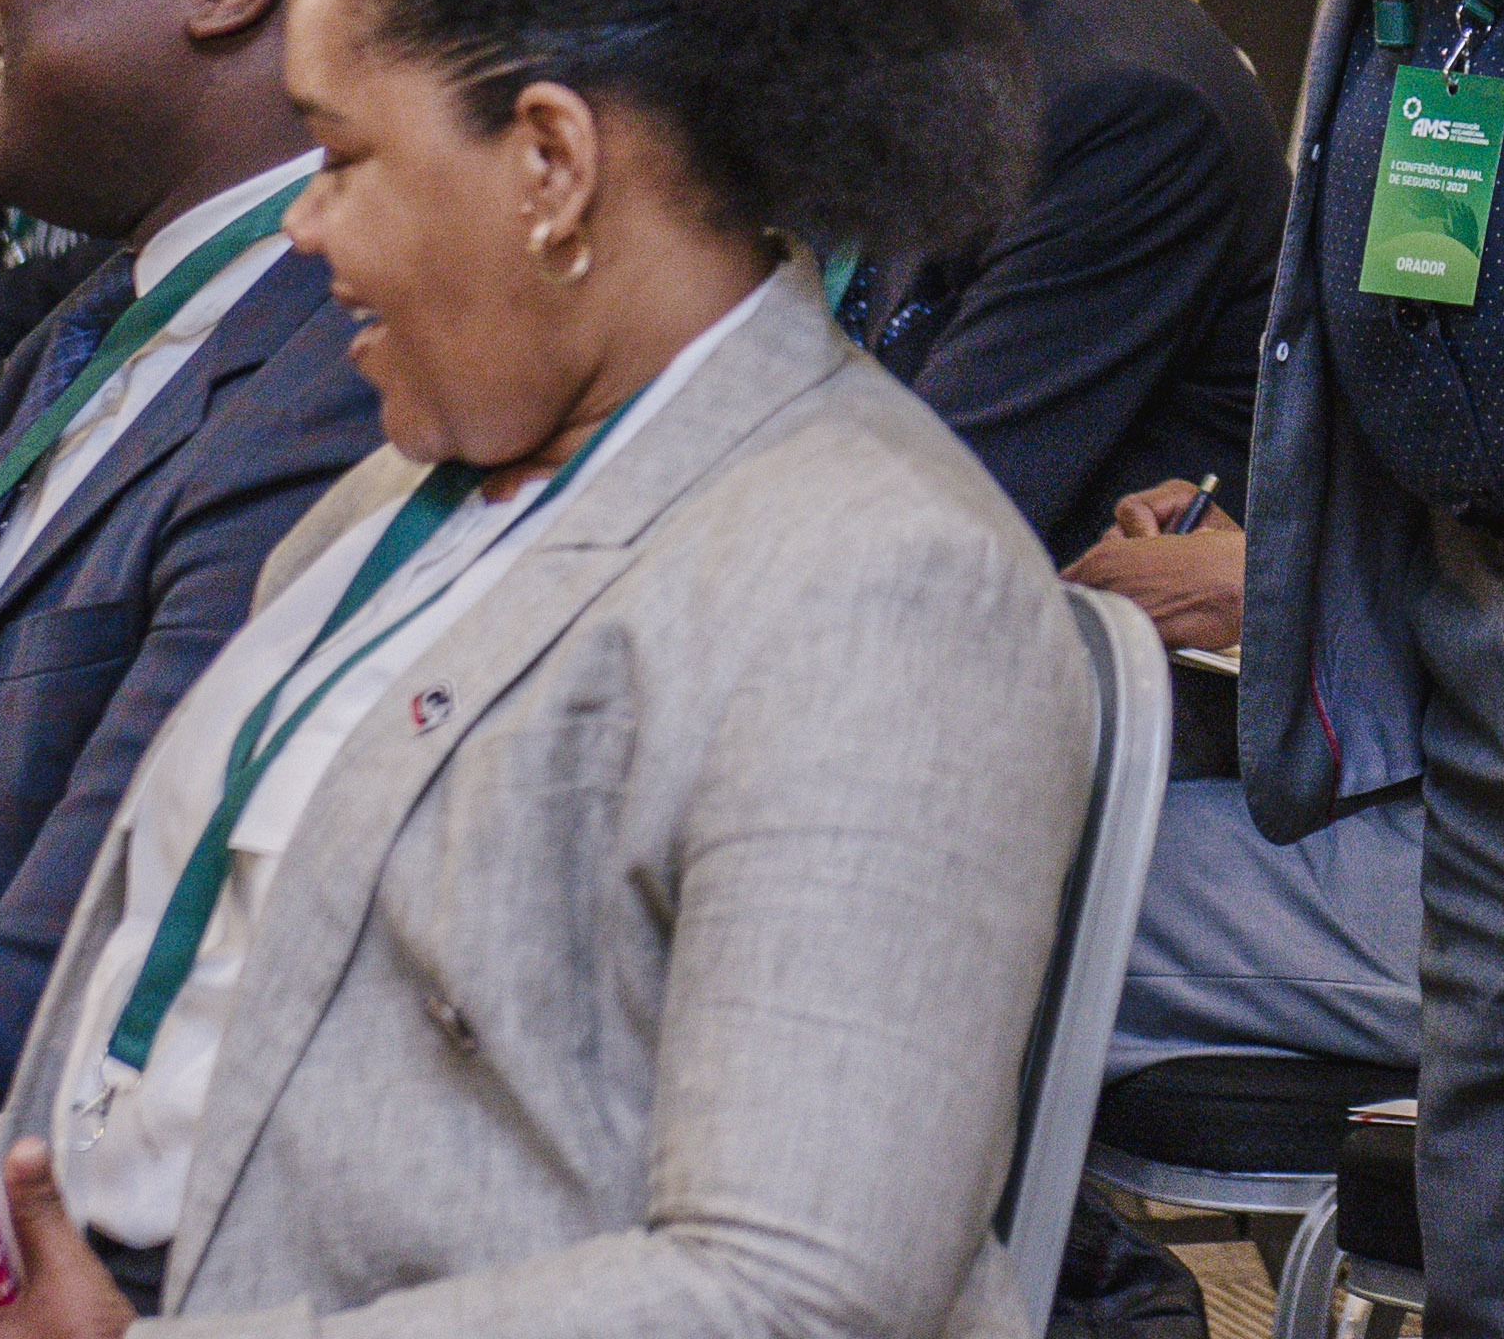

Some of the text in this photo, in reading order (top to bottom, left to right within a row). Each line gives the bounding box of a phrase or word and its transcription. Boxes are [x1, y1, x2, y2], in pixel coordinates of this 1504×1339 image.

[1411, 118, 1451, 140] AMS
[1396, 161, 1453, 177] CONFERÊNCIA
[1455, 169, 1483, 181] ANUAL
[1389, 173, 1401, 184] DE
[1402, 175, 1441, 190] SEGUROS
[1446, 181, 1468, 193] 2023
[1396, 257, 1446, 276] ORADOR
